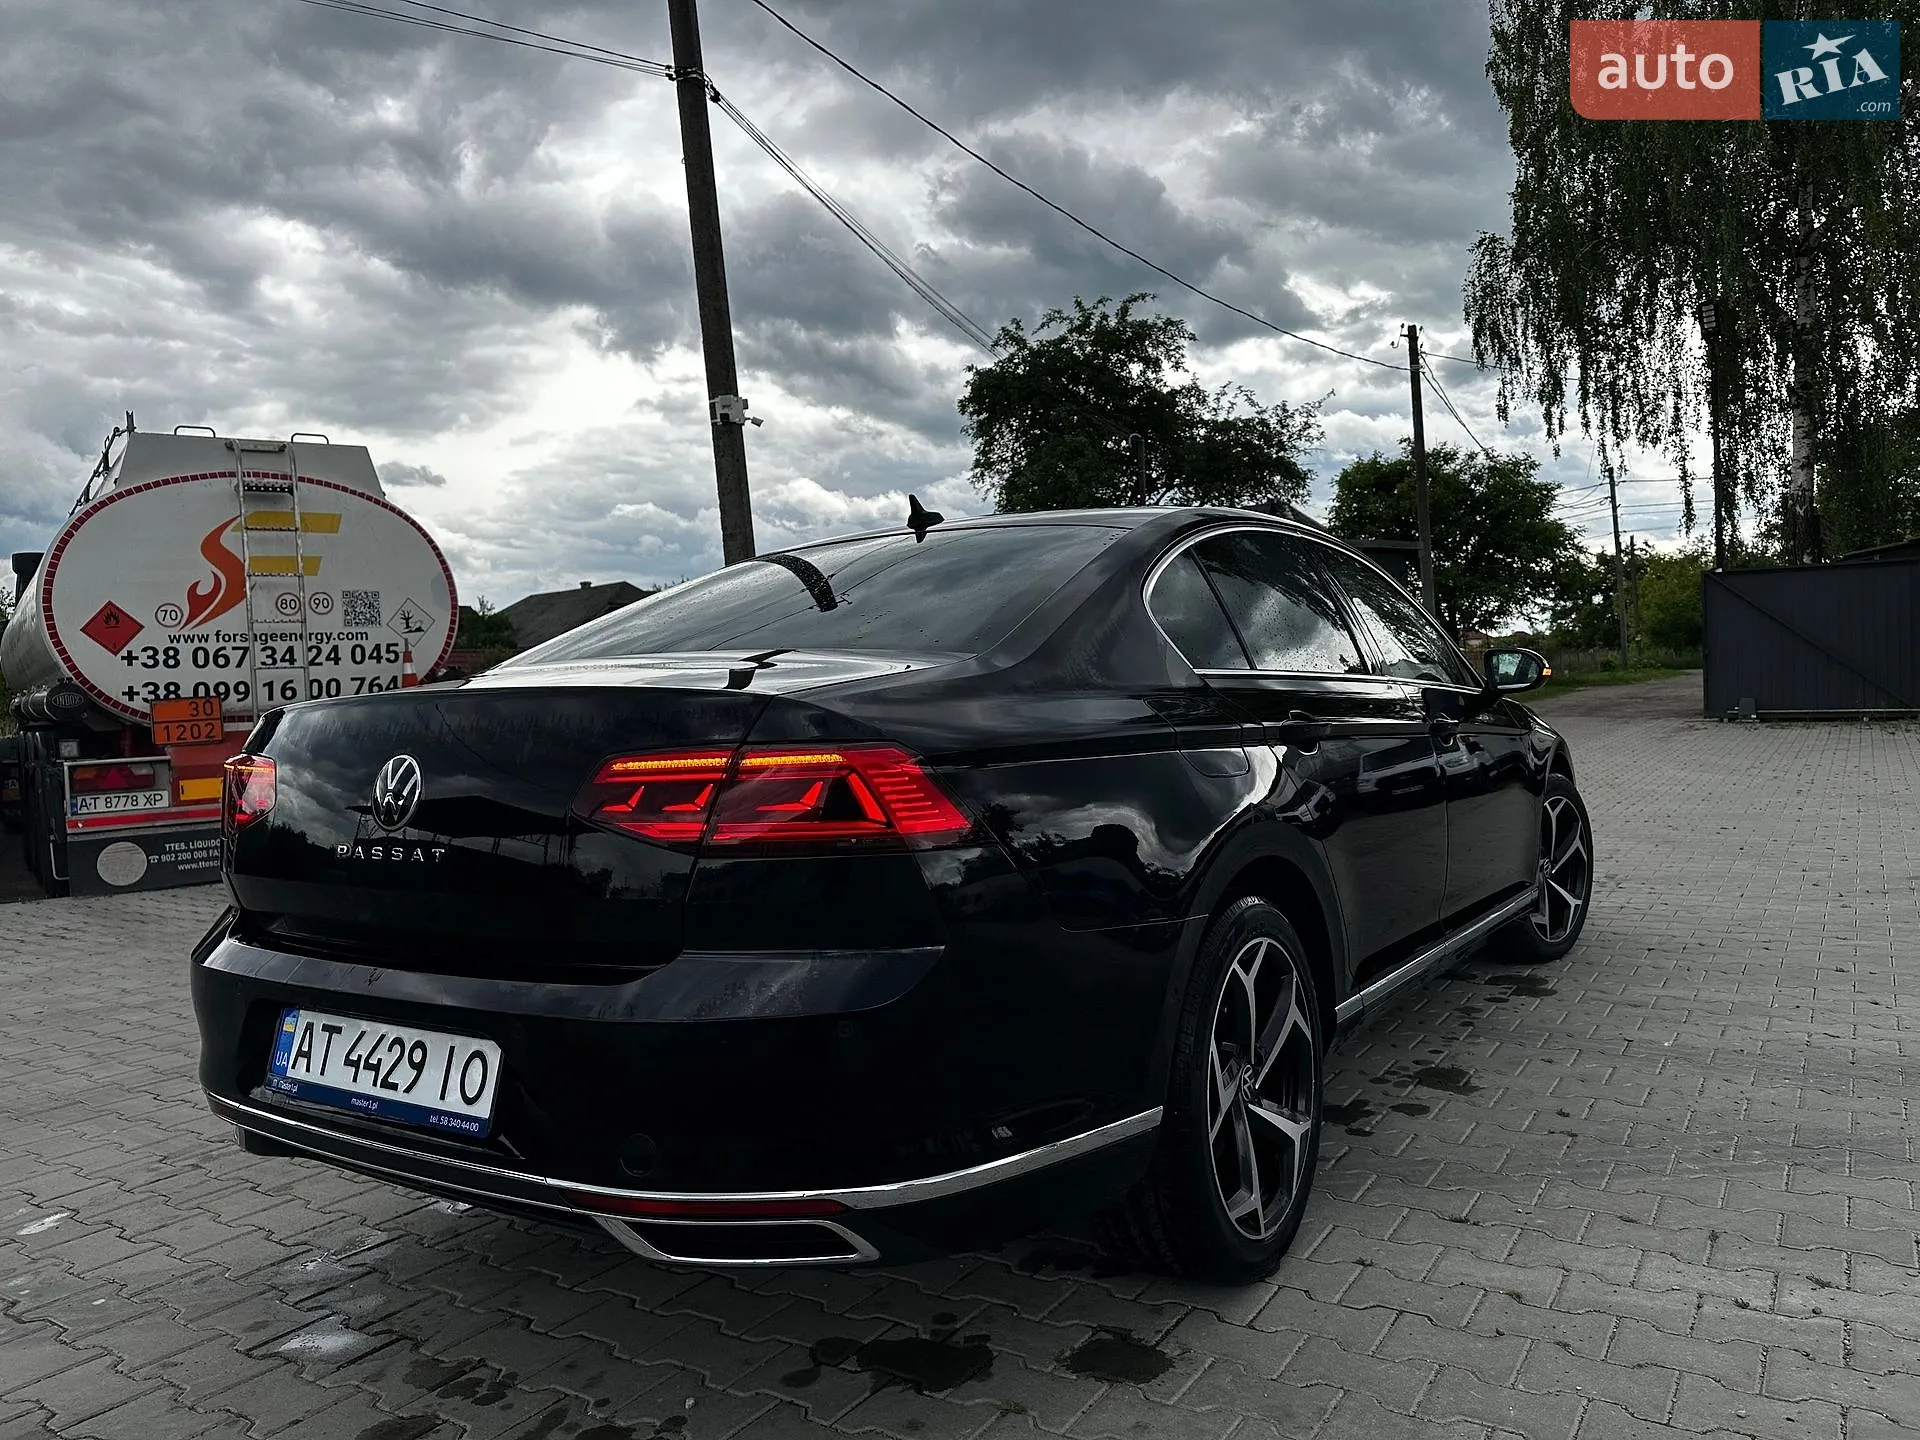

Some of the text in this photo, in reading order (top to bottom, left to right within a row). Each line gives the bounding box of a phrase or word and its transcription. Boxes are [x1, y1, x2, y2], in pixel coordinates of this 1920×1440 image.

[280, 598, 297, 610] 80
[313, 597, 330, 609] 90
[160, 609, 178, 622] 70
[121, 643, 400, 670] +38 067 34 24 045
[121, 675, 400, 704] +38 099 16 00 764
[56, 694, 80, 706] INDOX
[189, 699, 214, 718] 30
[163, 722, 217, 742] 1202
[79, 796, 100, 811] AT
[104, 794, 138, 809] 8778
[143, 793, 163, 807] XP
[160, 853, 176, 862] 902
[177, 852, 192, 861] 200
[208, 848, 220, 857] FA
[164, 842, 188, 852] TTES.
[336, 844, 445, 863] PASSAT
[275, 1050, 288, 1067] UA
[291, 1021, 488, 1106] AT 4429 IO
[429, 1114, 479, 1132] tel. 58 340 44 00
